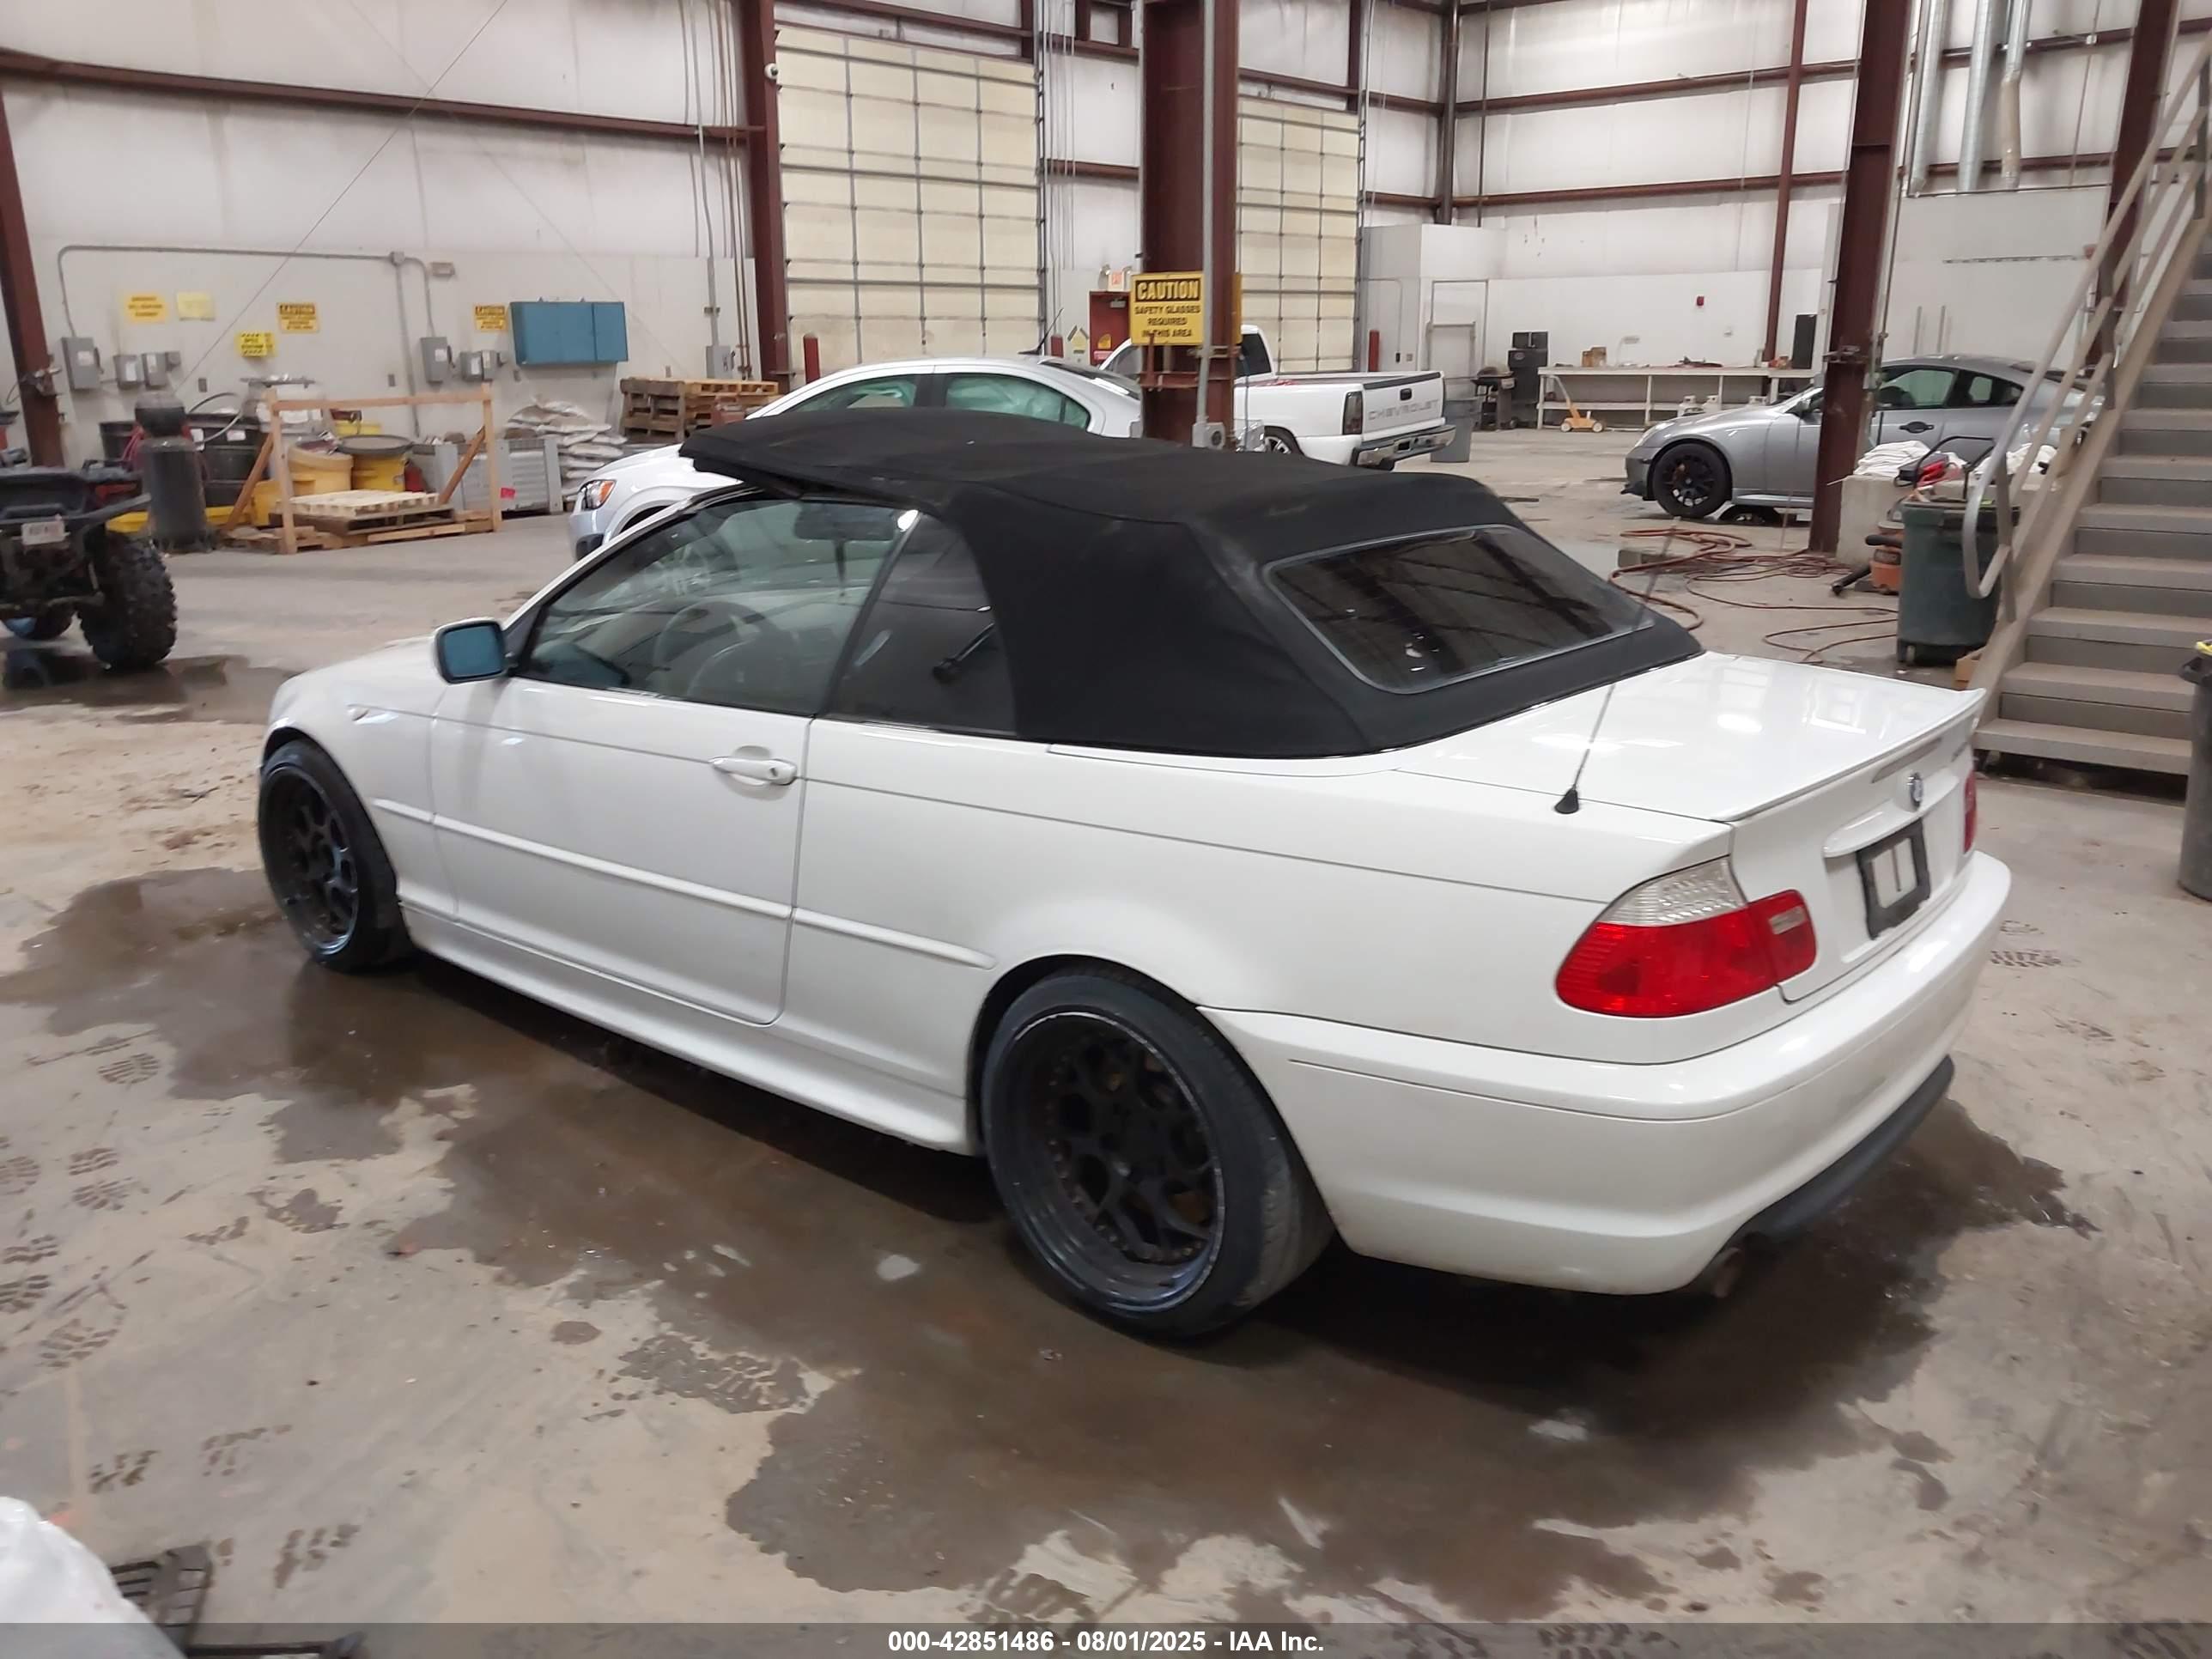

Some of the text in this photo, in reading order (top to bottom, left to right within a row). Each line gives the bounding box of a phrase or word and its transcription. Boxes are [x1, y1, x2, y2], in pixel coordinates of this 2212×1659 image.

[1137, 280, 1199, 301] CAUTION
[1134, 305, 1200, 315] SAFETY GLASSES
[1147, 317, 1188, 326] REQUIRED
[1171, 329, 1193, 337] AREA
[1368, 399, 1439, 420] CHEVROLET
